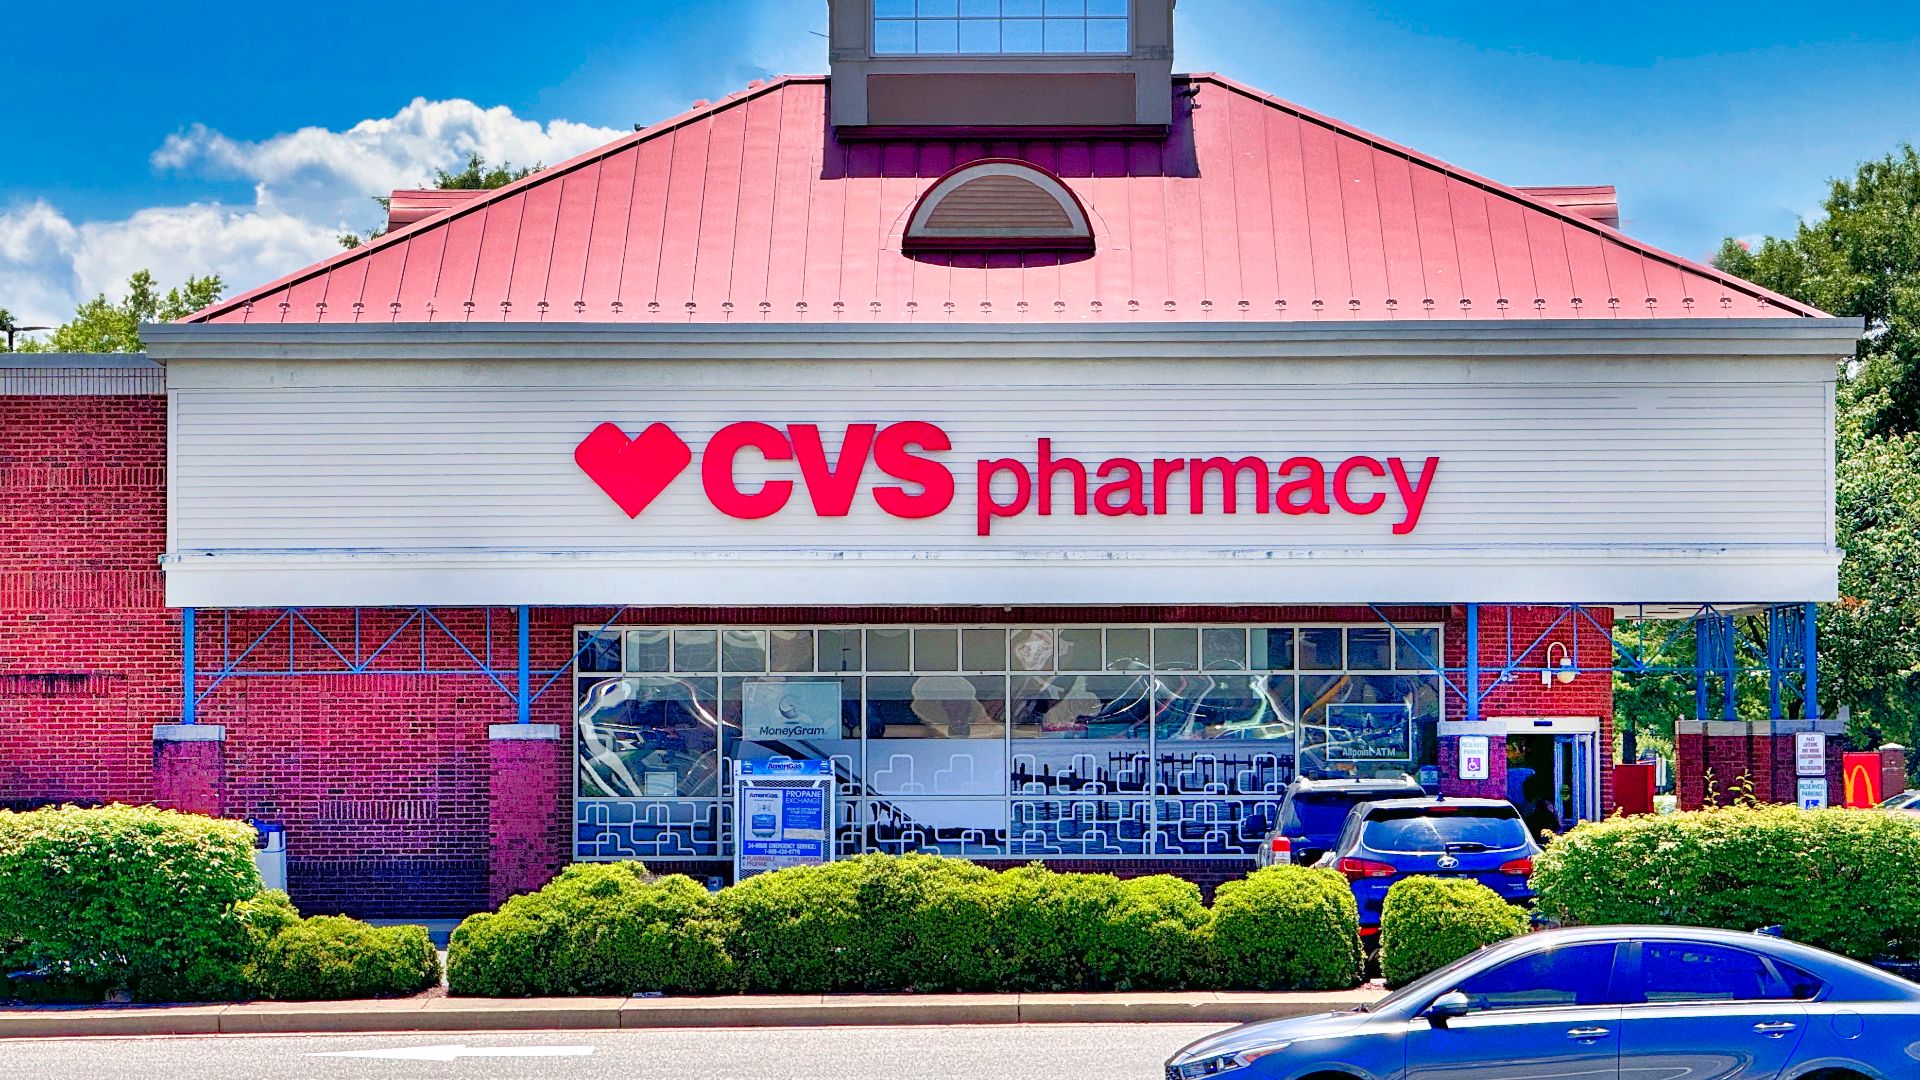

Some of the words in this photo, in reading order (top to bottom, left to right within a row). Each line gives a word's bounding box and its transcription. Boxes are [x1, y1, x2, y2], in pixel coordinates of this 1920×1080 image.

[702, 421, 954, 519] CVS
[977, 438, 1439, 536] pharmacy
[760, 725, 825, 737] MoneyGram
[1342, 747, 1371, 758] Allpoint
[1376, 747, 1396, 756] ATM
[785, 790, 822, 798] PROPANE
[785, 797, 821, 805] EXCHANGE
